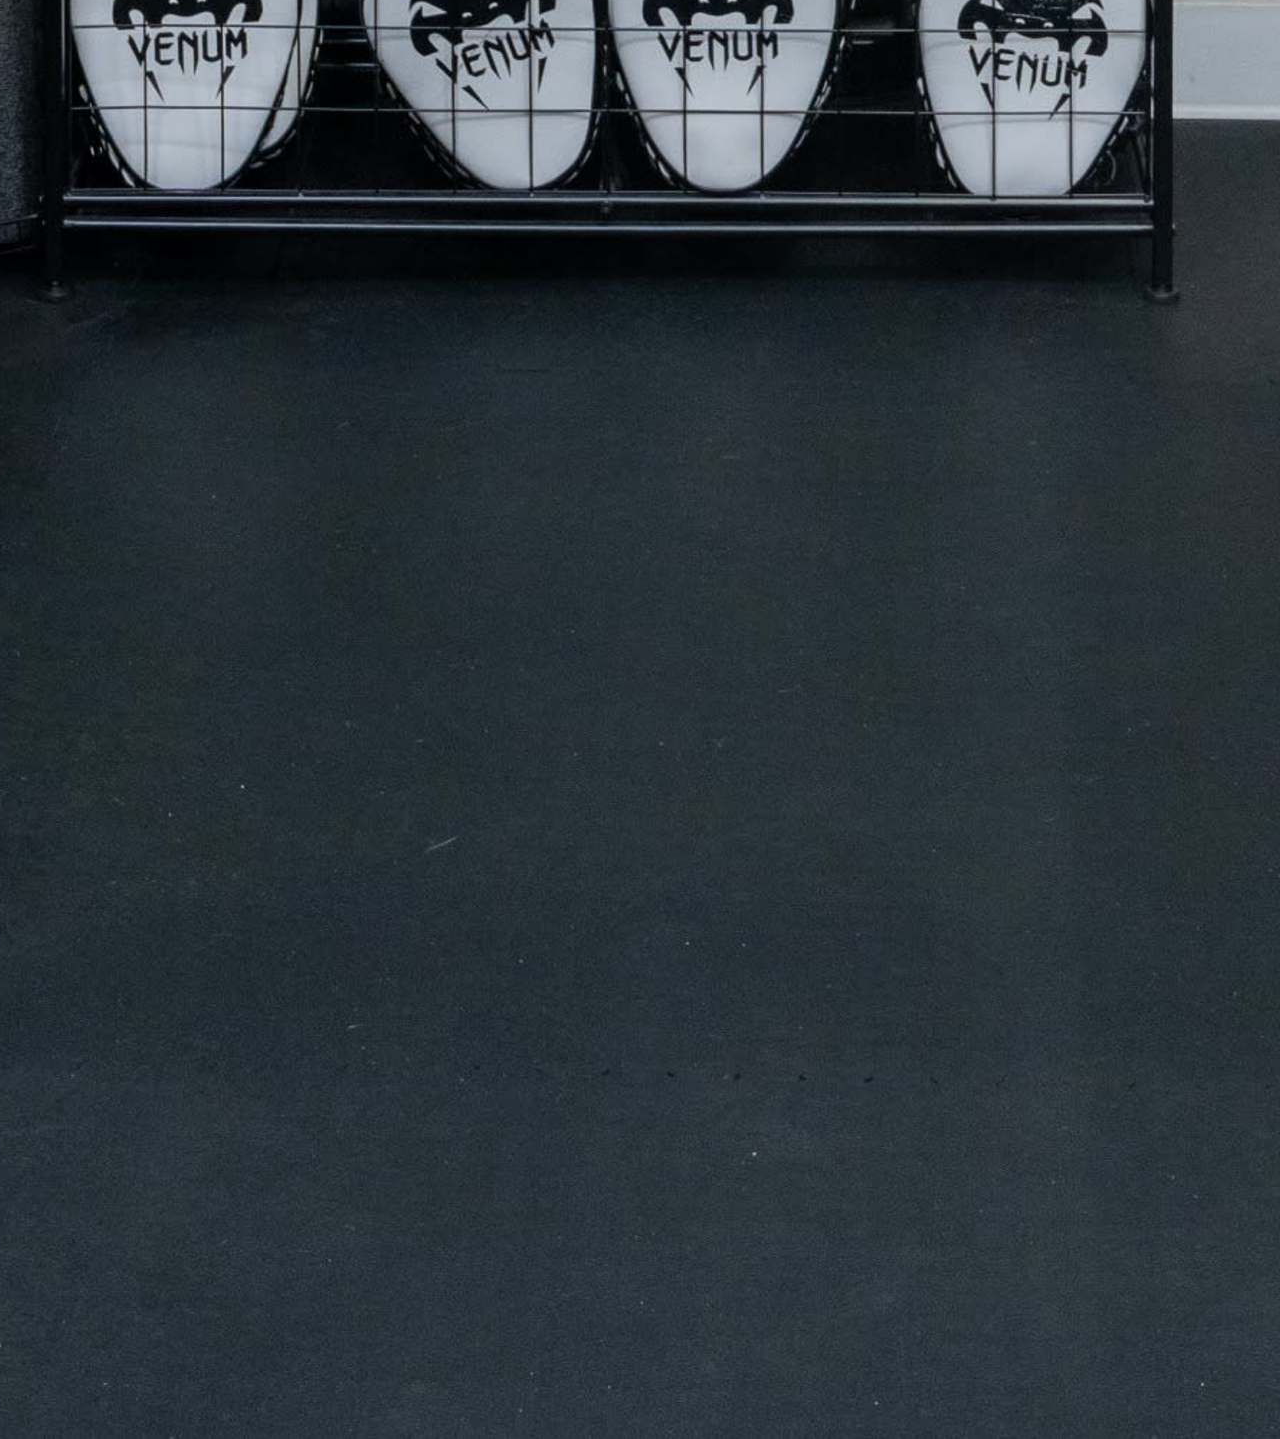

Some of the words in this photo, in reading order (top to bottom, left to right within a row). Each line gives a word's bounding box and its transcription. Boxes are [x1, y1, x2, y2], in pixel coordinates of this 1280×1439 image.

[128, 27, 248, 75] VENUM
[435, 19, 555, 84] VENUM
[657, 29, 779, 71] VENUM
[969, 44, 1088, 93] VENUM
